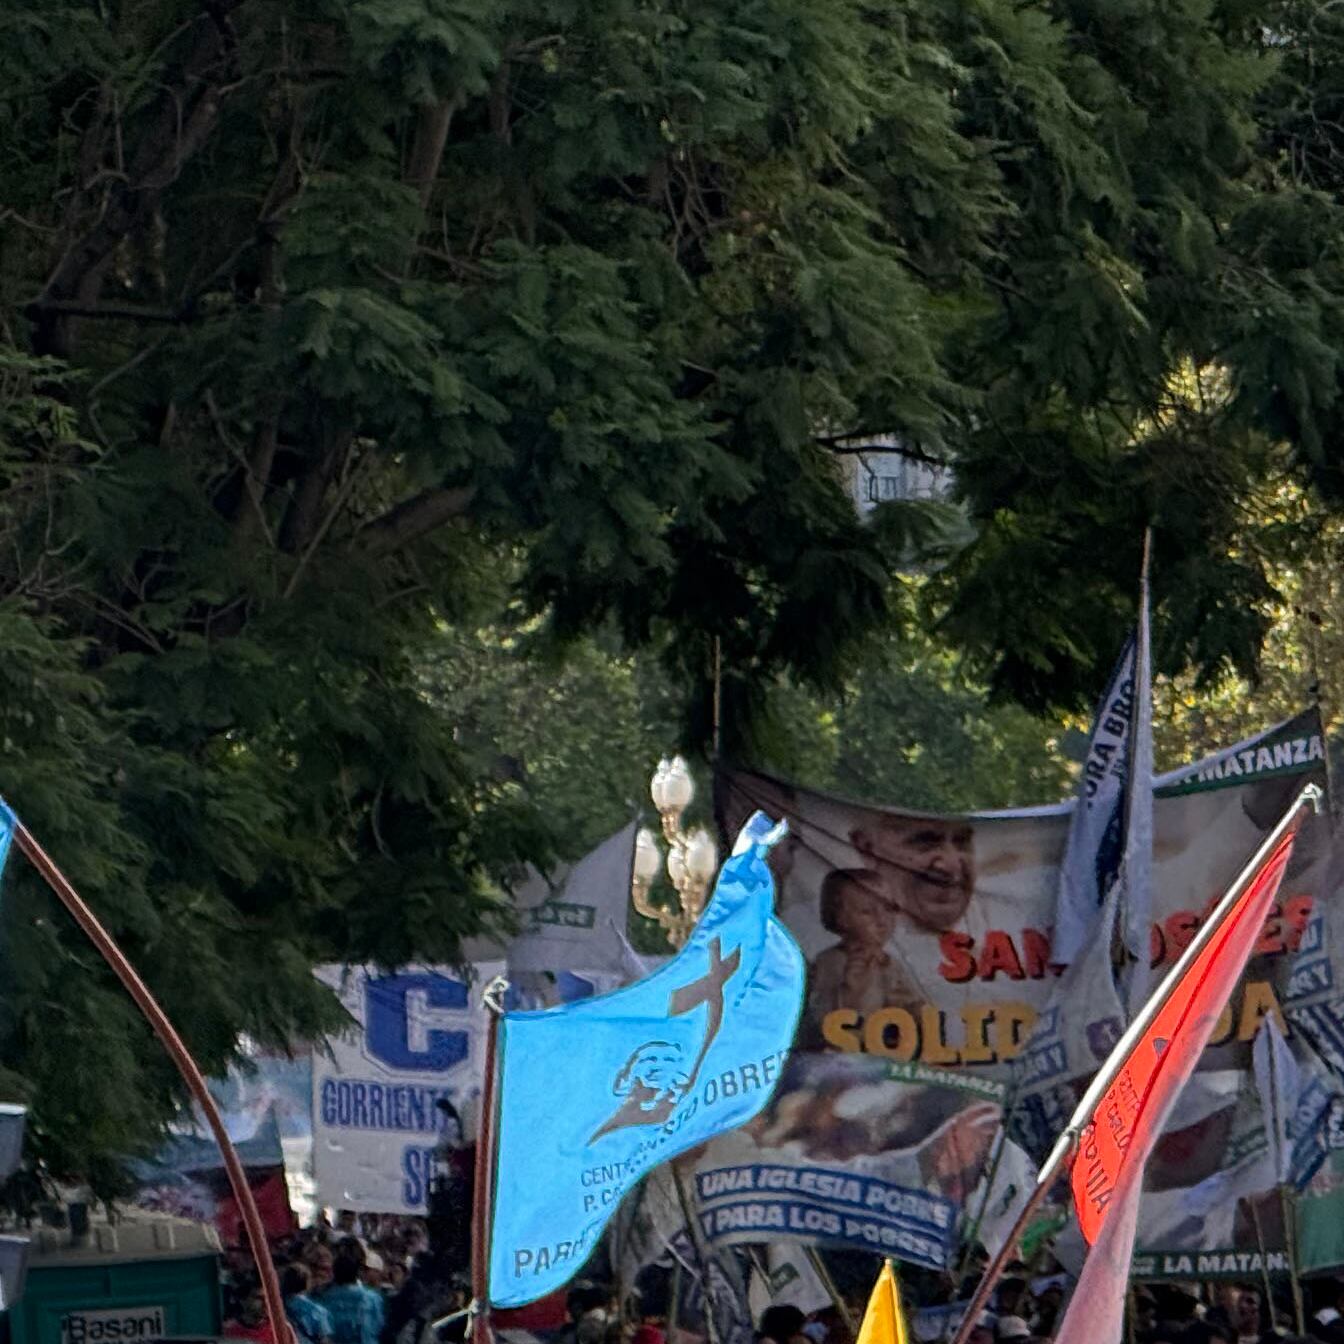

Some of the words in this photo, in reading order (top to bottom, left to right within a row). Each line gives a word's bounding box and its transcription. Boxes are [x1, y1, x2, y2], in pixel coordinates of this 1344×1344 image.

[702, 1171, 753, 1195] UNA
[757, 1168, 862, 1203] IGLESIA
[716, 1204, 786, 1231] PARA
[789, 1207, 842, 1235] LOS
[1163, 1254, 1192, 1273] LA
[65, 1310, 163, 1341] Basani
